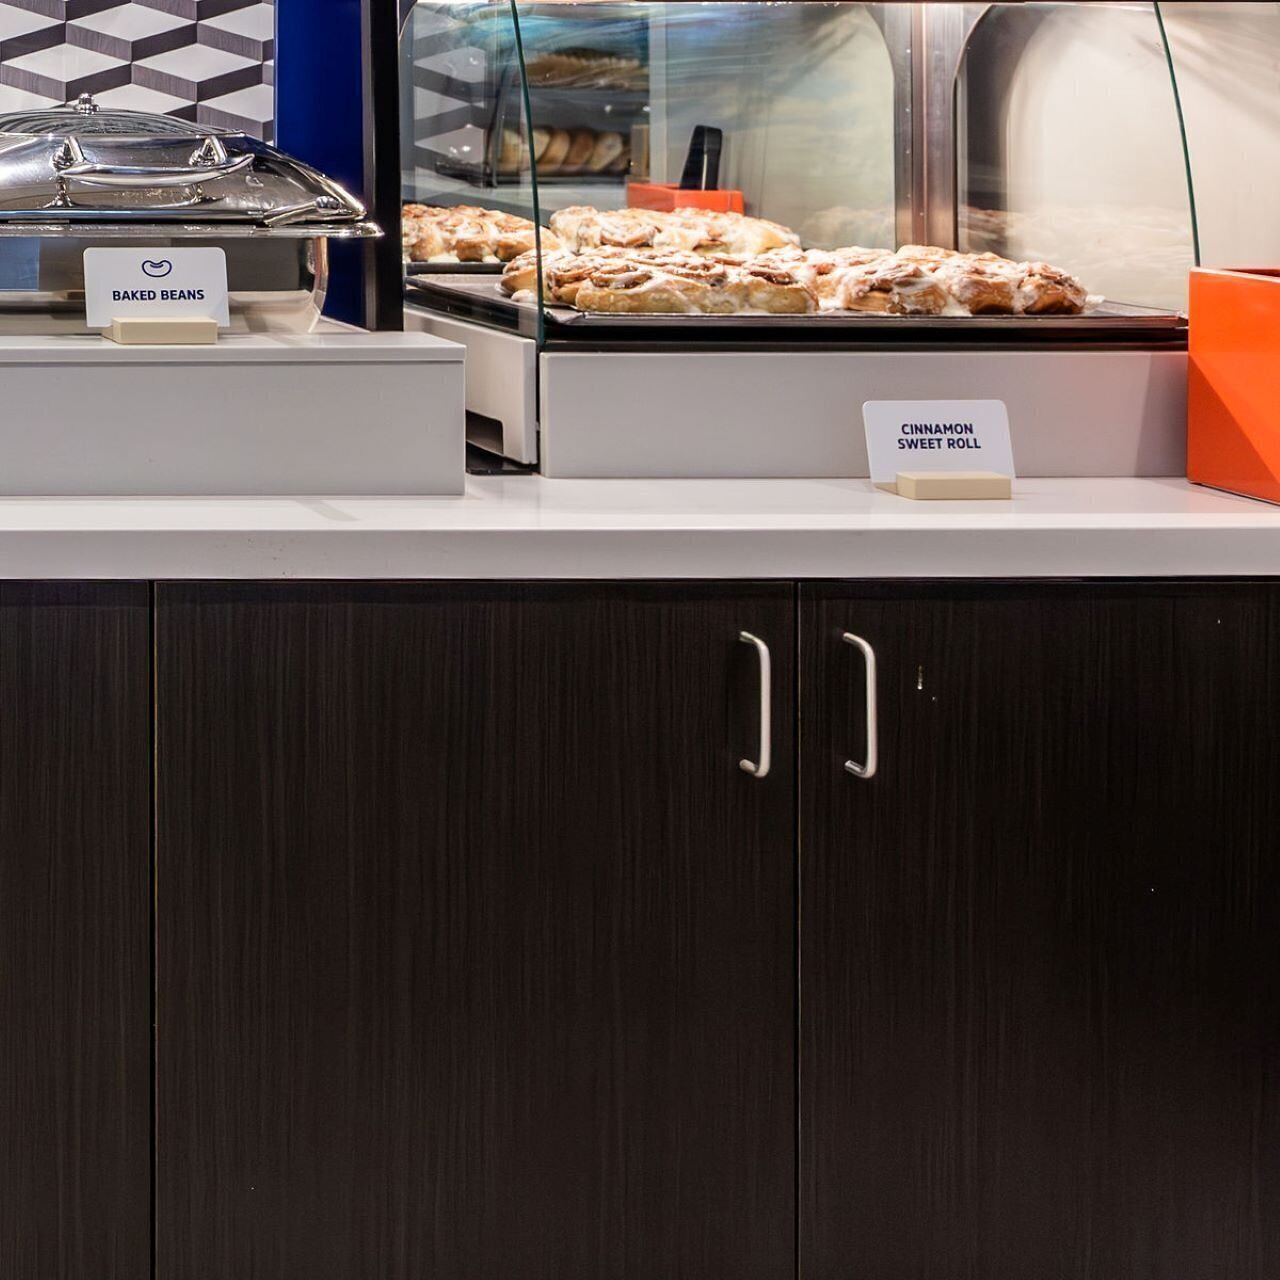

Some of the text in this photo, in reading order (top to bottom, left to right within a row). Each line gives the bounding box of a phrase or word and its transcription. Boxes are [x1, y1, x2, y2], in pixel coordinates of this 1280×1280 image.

[112, 289, 205, 301] BAKED BEANS
[901, 423, 974, 436] CINNAMON
[897, 437, 982, 450] SWEET ROLL
